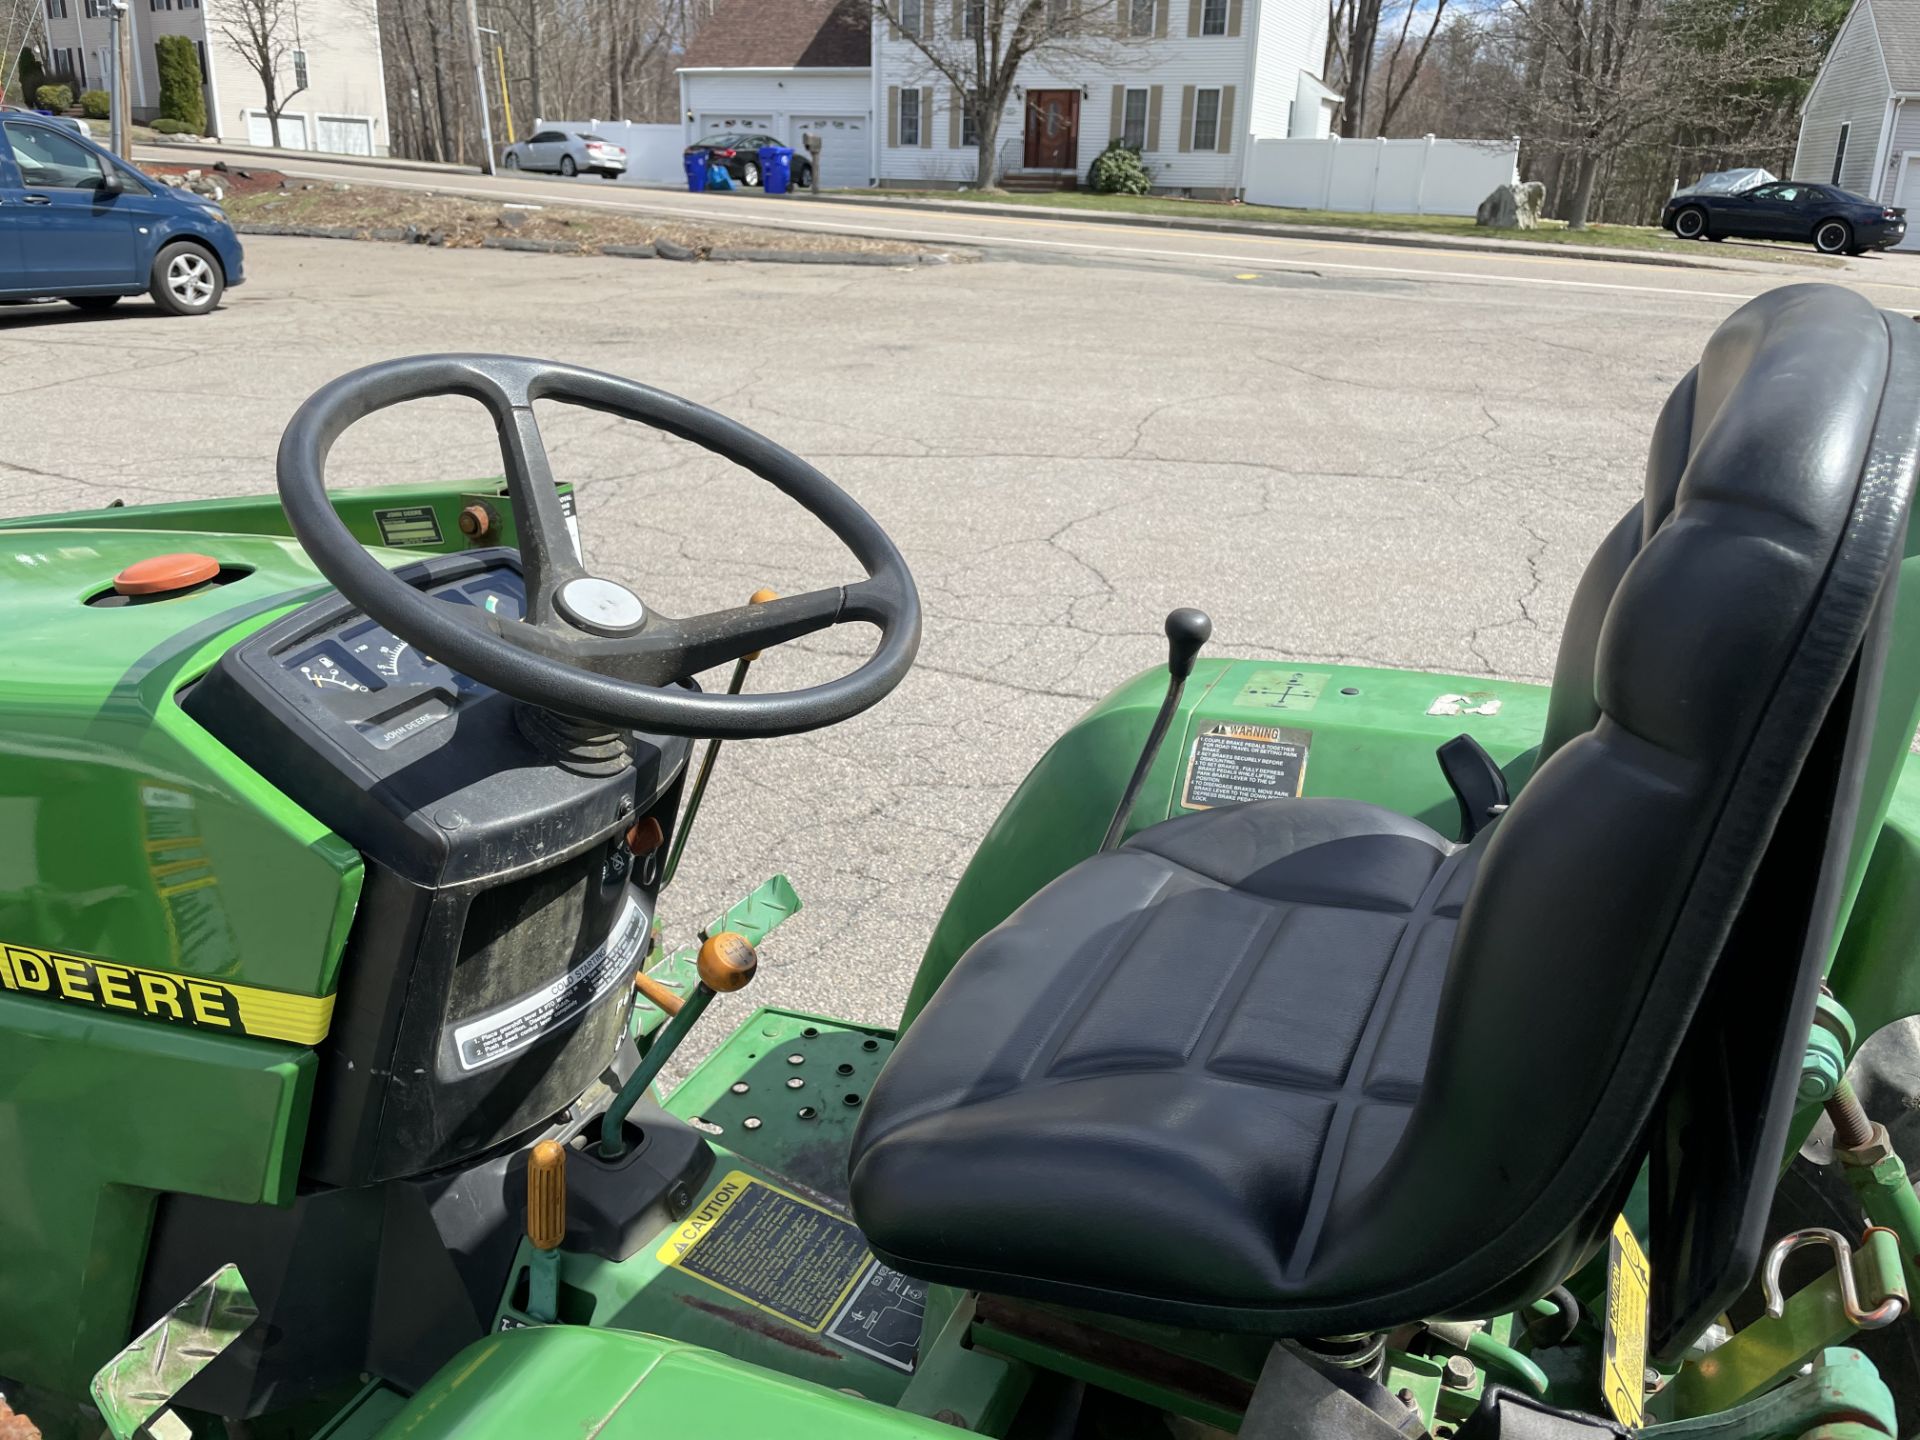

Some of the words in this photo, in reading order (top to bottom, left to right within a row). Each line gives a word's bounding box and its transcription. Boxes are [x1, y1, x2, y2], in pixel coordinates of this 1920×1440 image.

[384, 727, 407, 741] JOHN
[404, 713, 431, 730] DEERE
[1231, 725, 1278, 739] WARNING
[1260, 768, 1284, 776] DEPRESS
[8, 949, 232, 1028] DEERE
[551, 976, 574, 994] COLD
[575, 948, 606, 978] STARTING
[482, 1032, 498, 1041] Place
[500, 1019, 523, 1034] gearshift
[524, 1012, 537, 1021] lever
[544, 1001, 555, 1010] PTO
[483, 1035, 502, 1047] neutral
[528, 1008, 554, 1025] Disengage
[485, 1043, 499, 1052] Push
[502, 1034, 518, 1046] speed
[521, 1024, 538, 1036] control
[540, 1016, 552, 1026] lever
[682, 1182, 739, 1239] CAUTION
